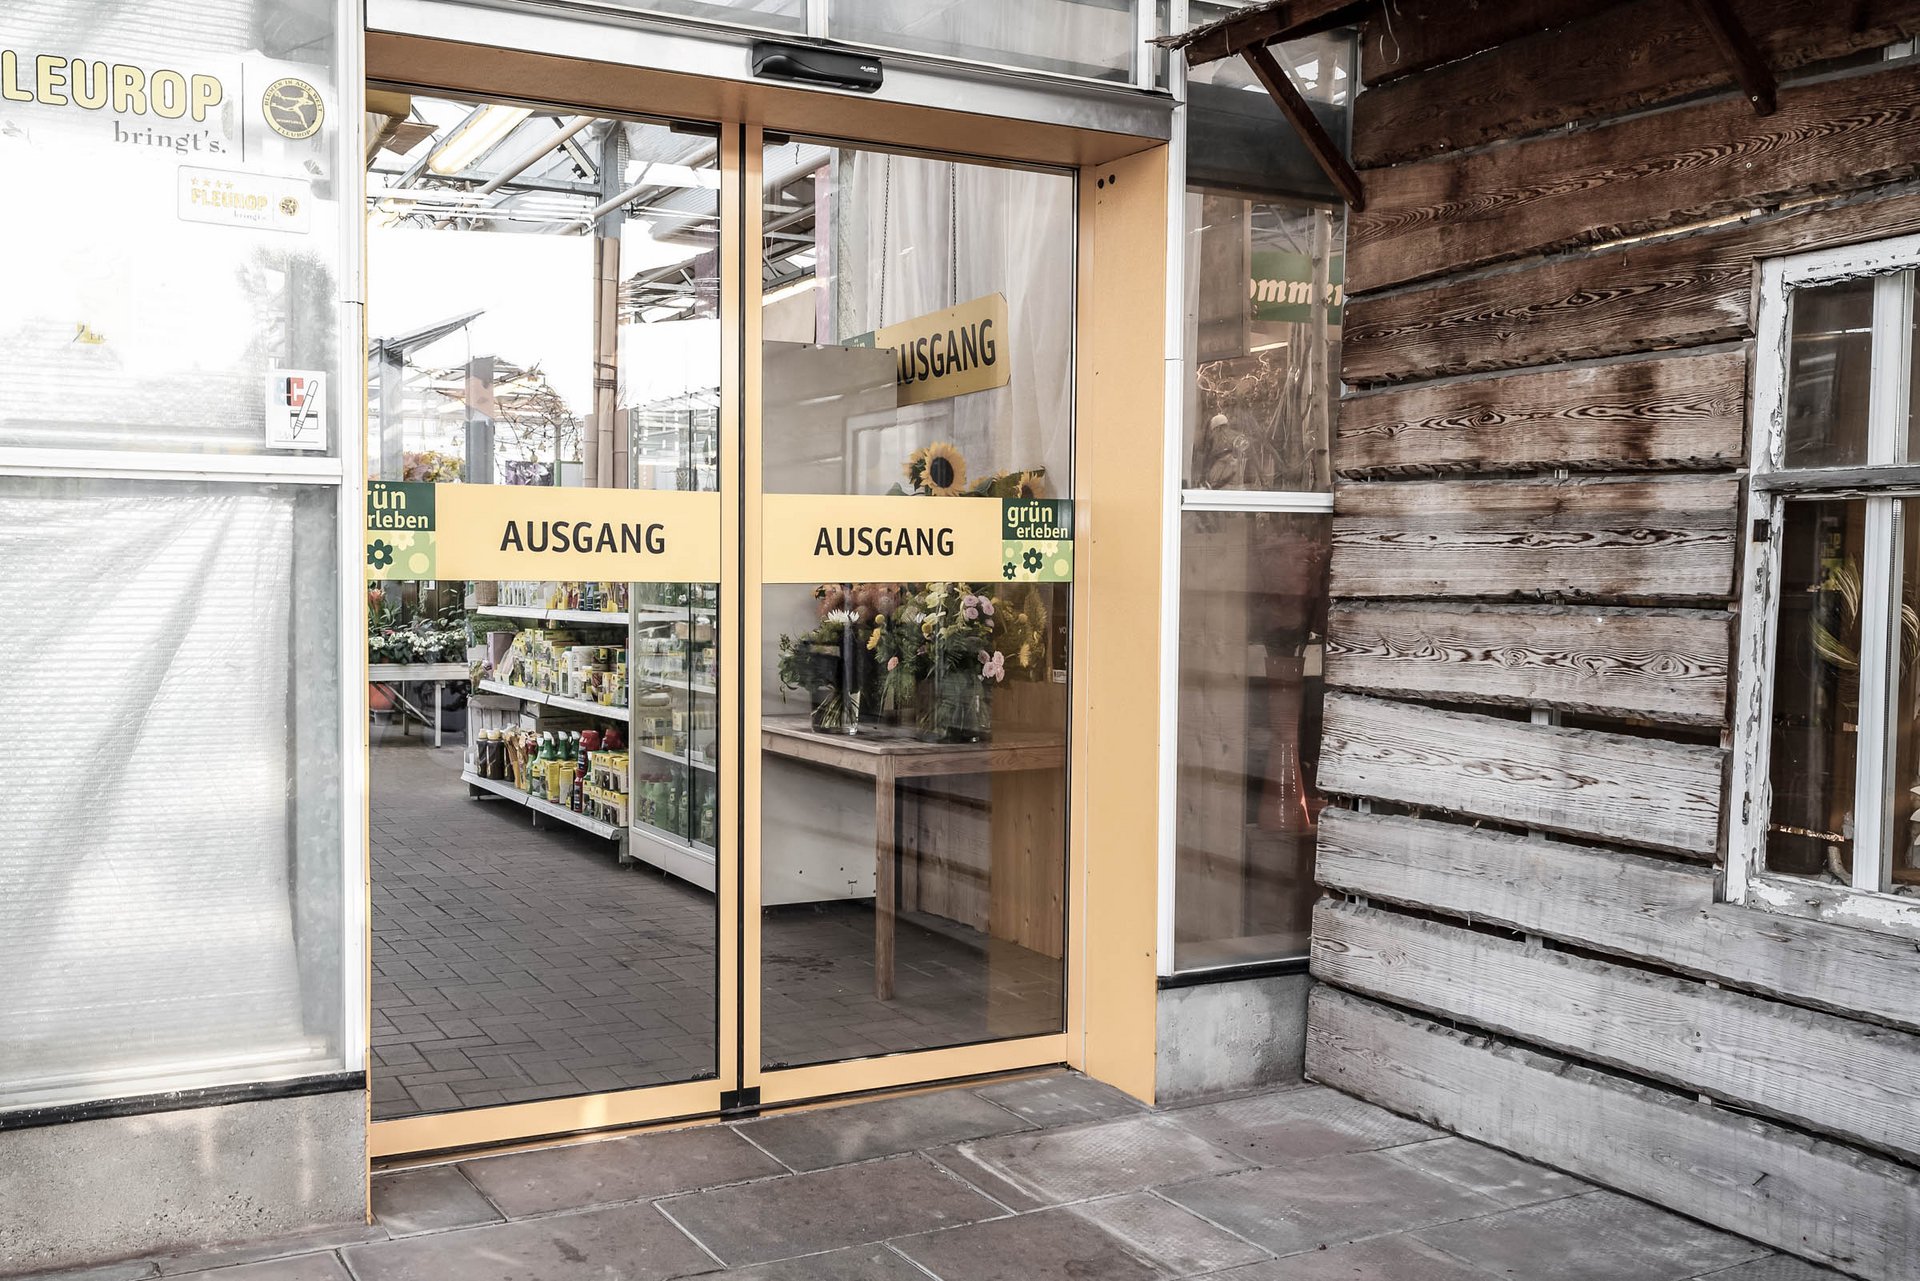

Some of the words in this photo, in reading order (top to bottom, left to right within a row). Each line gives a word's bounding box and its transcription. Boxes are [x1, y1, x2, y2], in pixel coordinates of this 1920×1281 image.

[2, 50, 223, 122] LEUROP
[112, 120, 226, 155] bringt's.
[368, 510, 429, 529] rleben
[1007, 501, 1053, 528] grün
[500, 520, 665, 554] AUSGANG
[813, 527, 954, 556] AUSGANG
[1016, 523, 1068, 538] erleben
